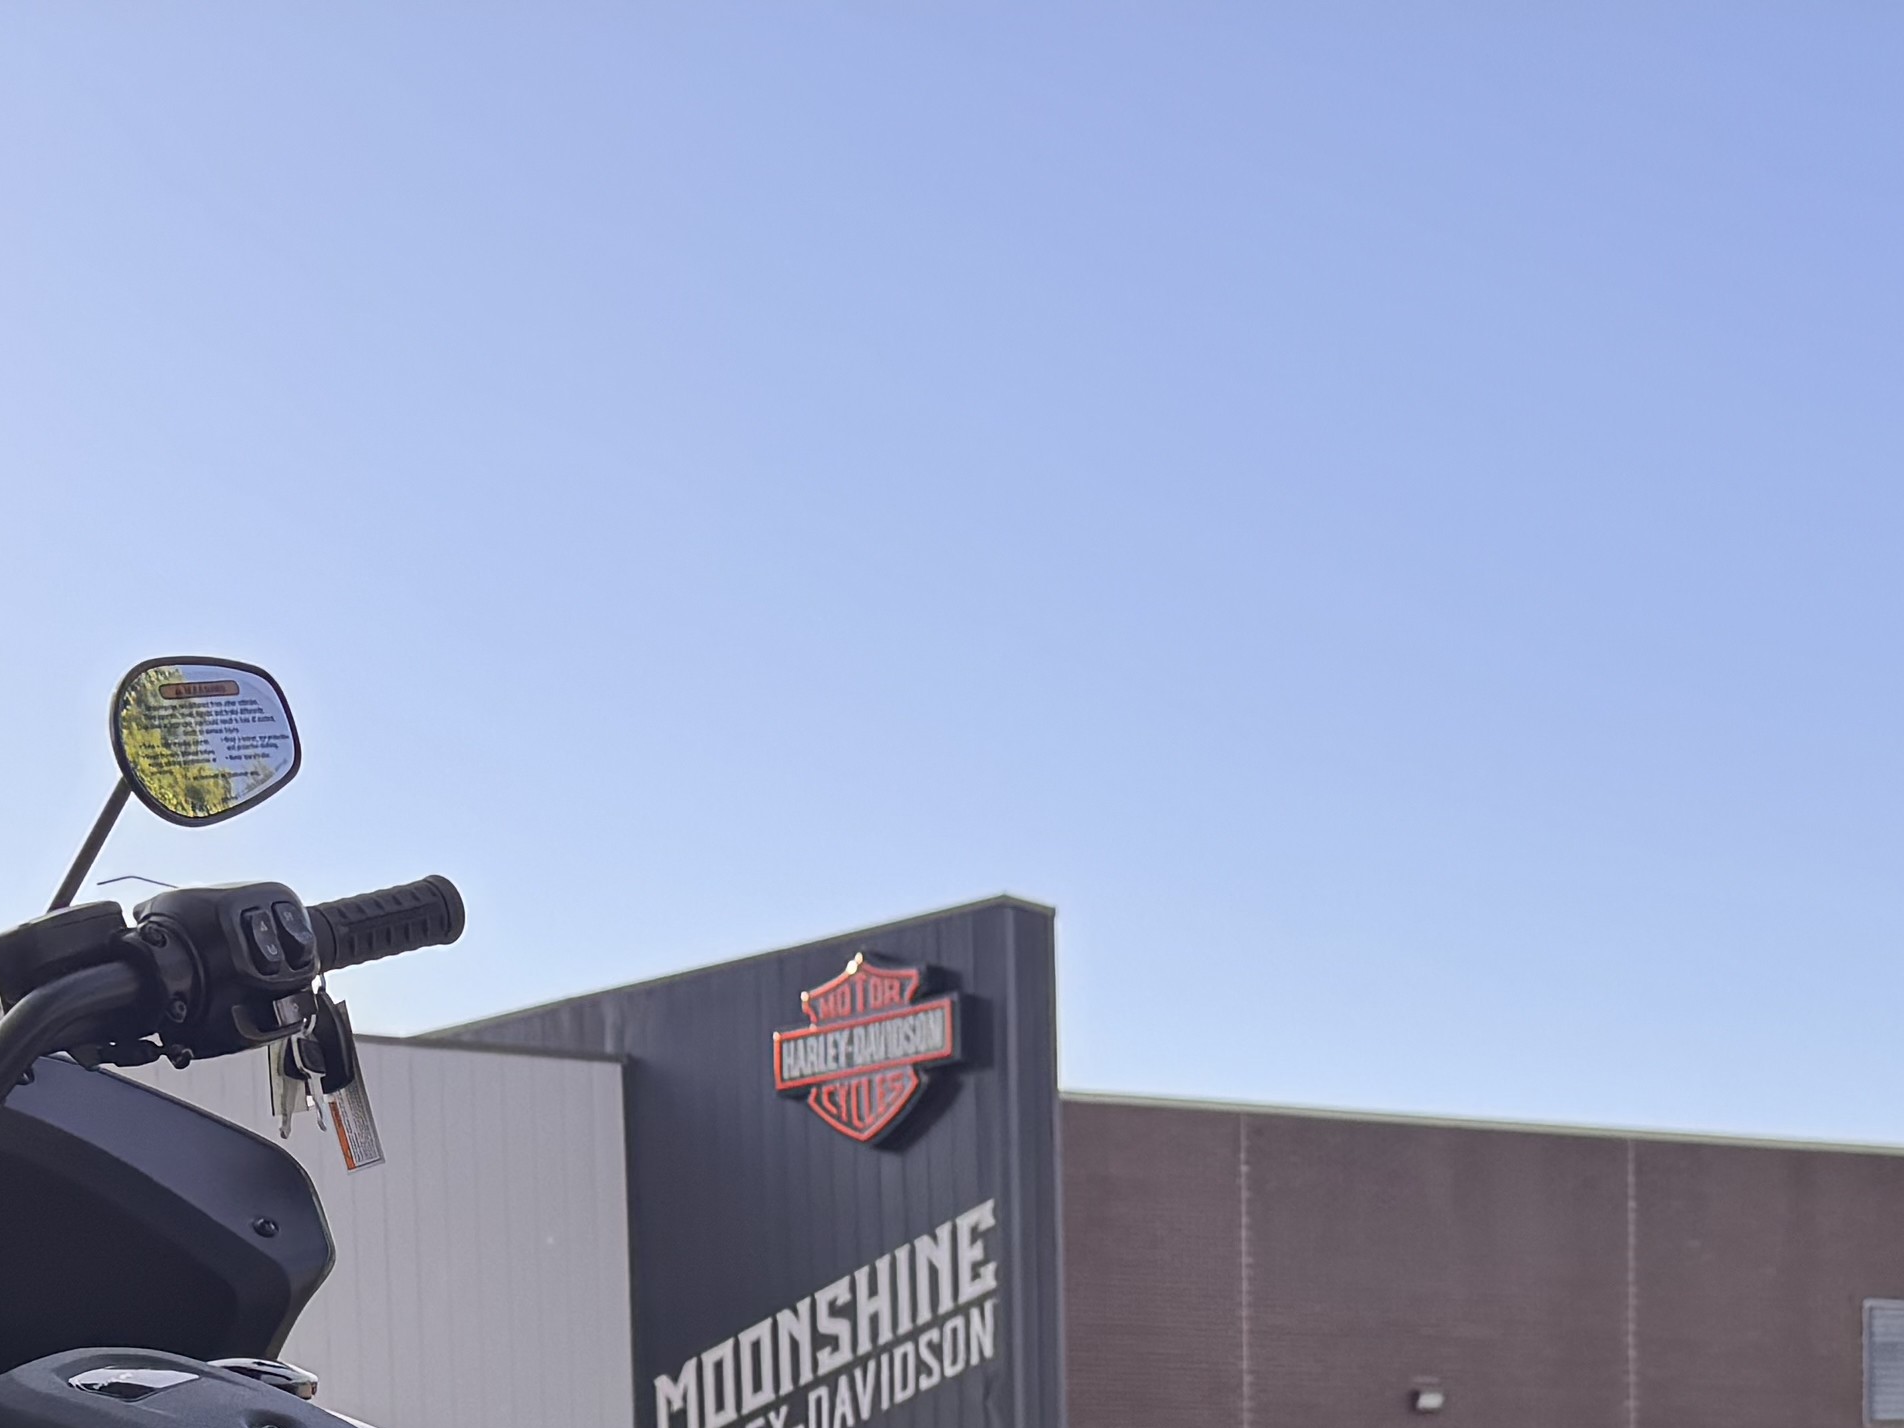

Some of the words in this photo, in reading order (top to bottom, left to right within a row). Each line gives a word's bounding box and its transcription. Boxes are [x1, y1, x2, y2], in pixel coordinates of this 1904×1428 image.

[817, 974, 902, 1019] MOTOR
[782, 1009, 944, 1079] HARLEY-DAVIDSON
[821, 1073, 906, 1129] CYCLES
